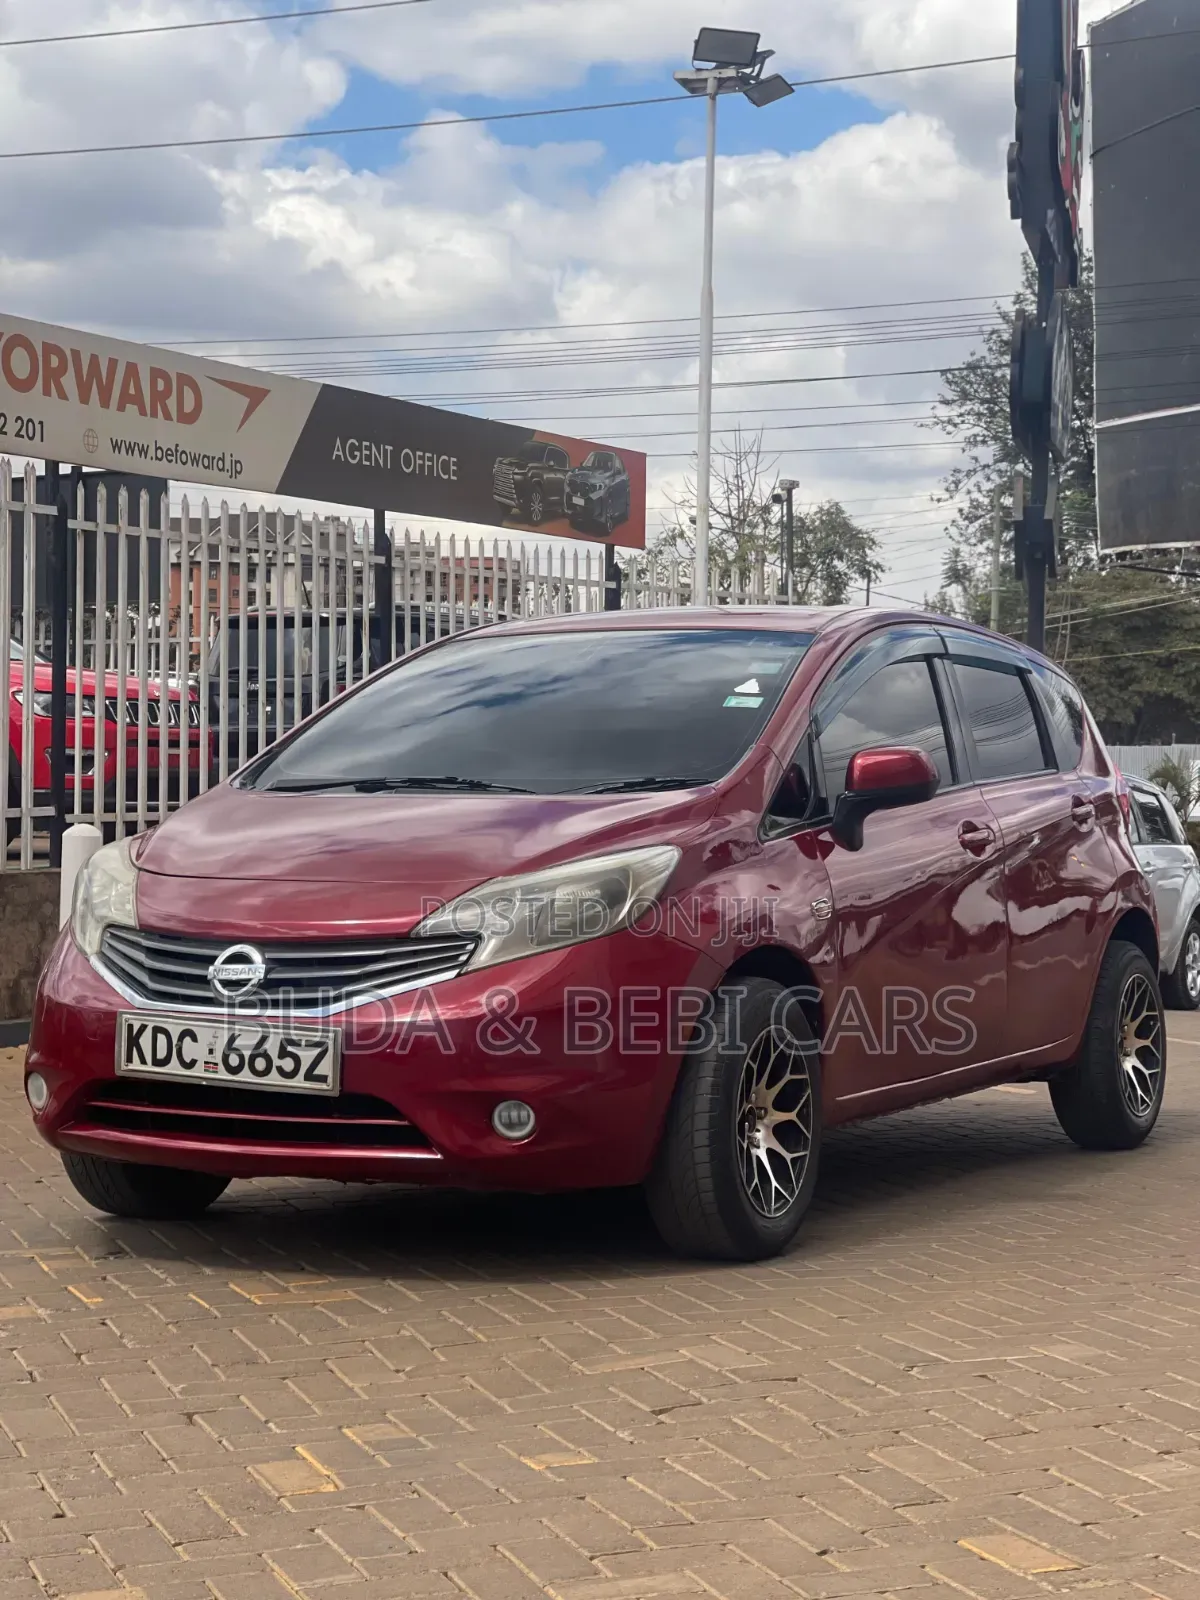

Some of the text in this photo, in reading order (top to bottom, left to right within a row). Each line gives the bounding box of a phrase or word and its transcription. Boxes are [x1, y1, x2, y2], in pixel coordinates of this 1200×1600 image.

[0, 331, 203, 425] ORWARD
[14, 415, 45, 443] 201
[110, 436, 243, 479] www.befoward.jp
[332, 436, 458, 481] AGENT OFFICE
[212, 967, 257, 977] NISSAN
[126, 1022, 199, 1070] KDC
[221, 1032, 329, 1083] 665Z
